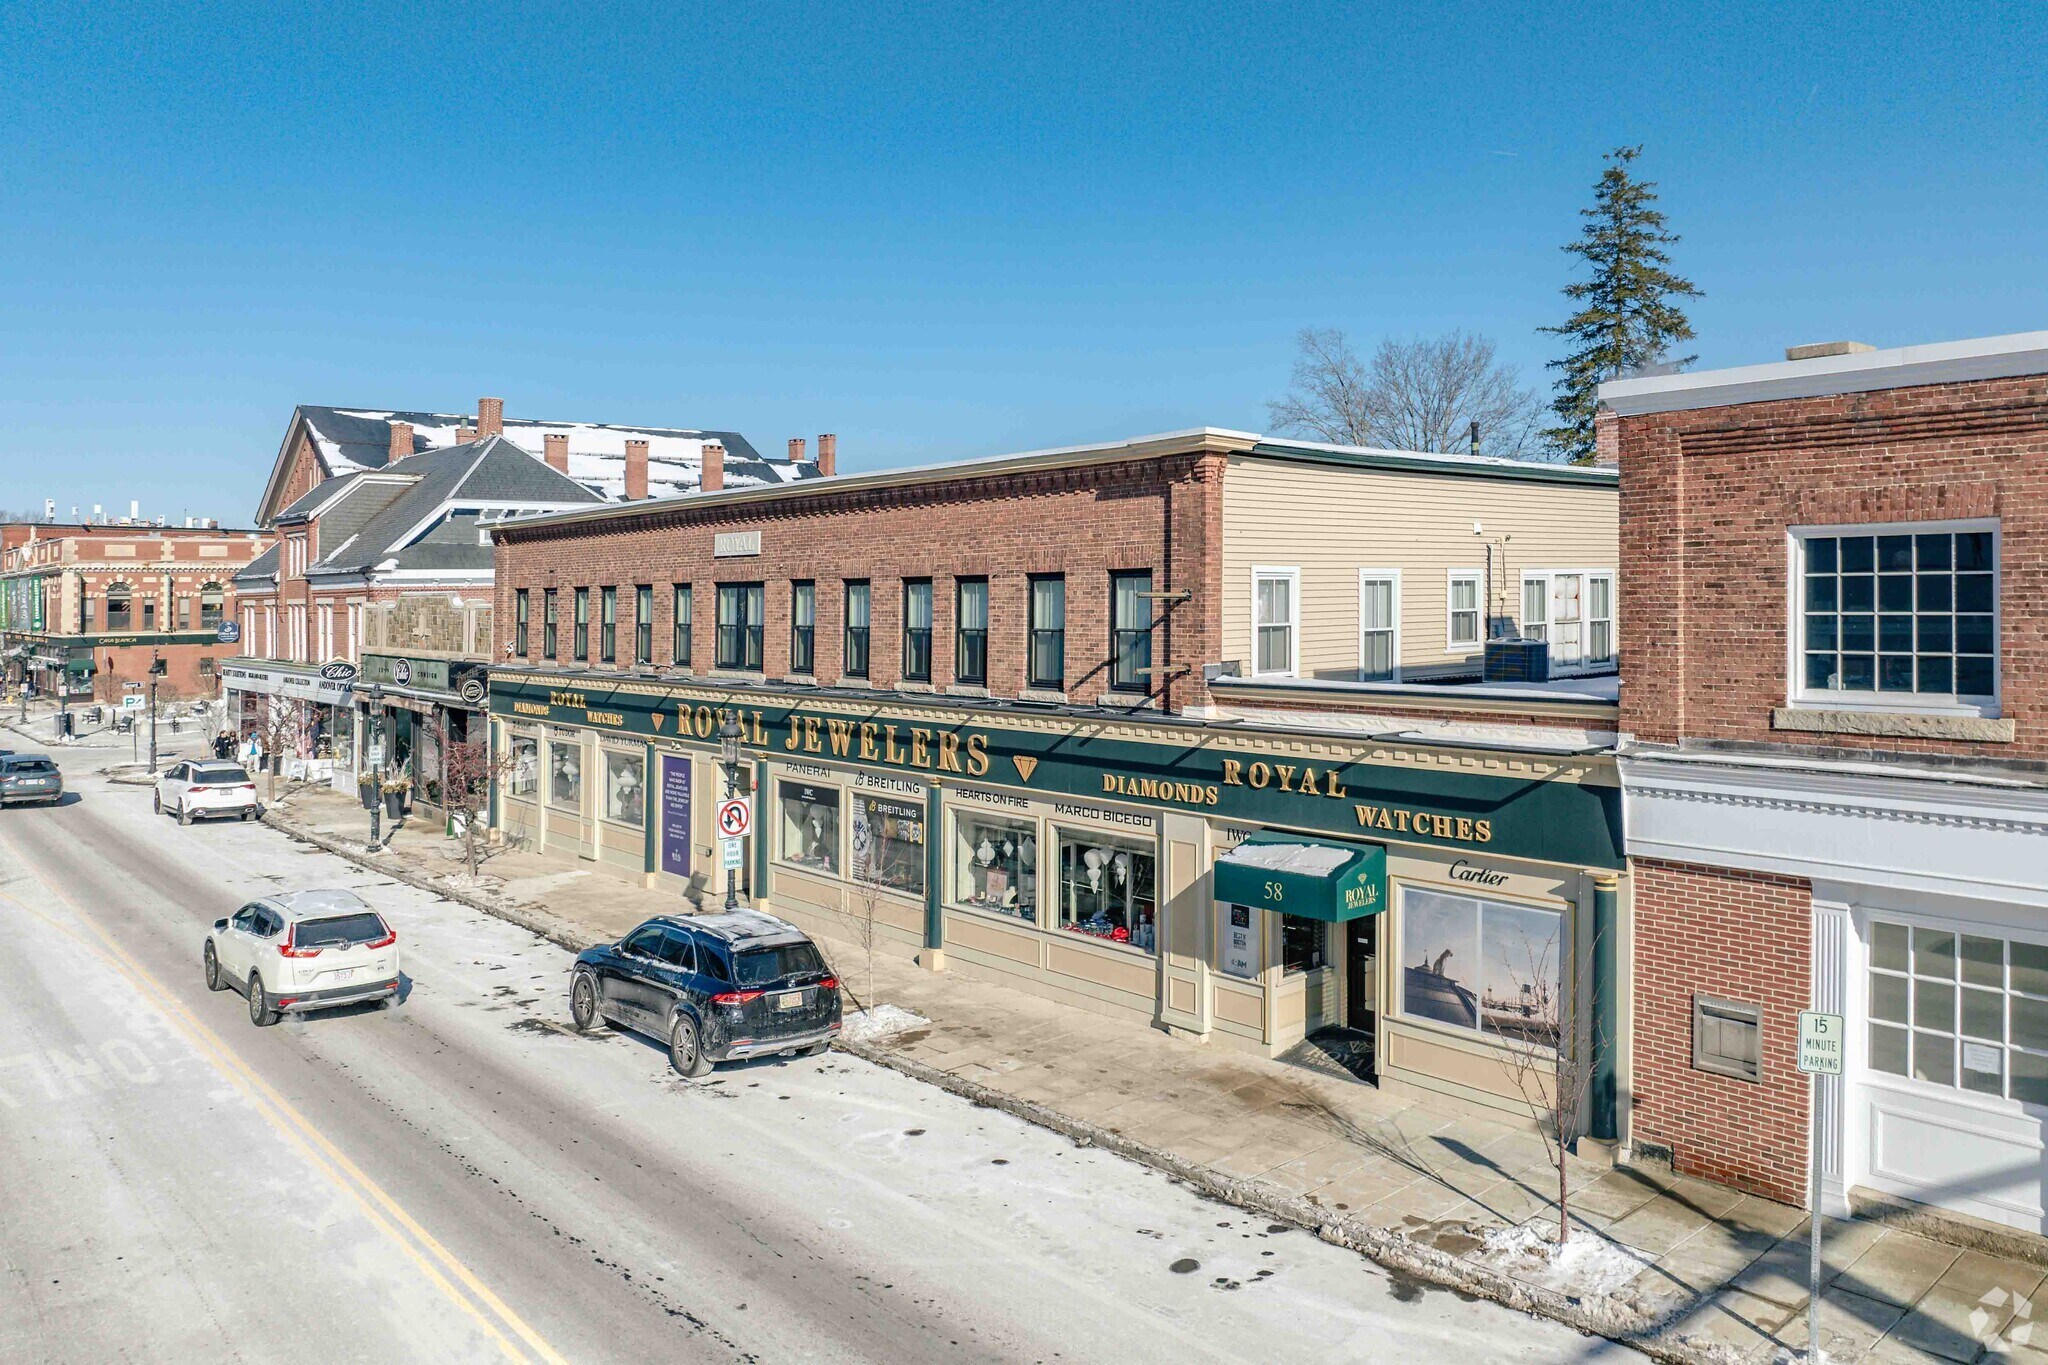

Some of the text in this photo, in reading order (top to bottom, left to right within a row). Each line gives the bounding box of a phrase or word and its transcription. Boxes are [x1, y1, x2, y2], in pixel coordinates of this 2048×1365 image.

[718, 535, 755, 553] ROYAL
[325, 665, 353, 678] Chic
[550, 691, 587, 709] ROYAL
[513, 702, 624, 727] DIAMONDS WATCHES
[600, 735, 619, 745] DAVID
[676, 703, 989, 777] ROYAL JEWELERS
[786, 762, 831, 778] PANERAI
[1222, 758, 1347, 799] ROYAL
[867, 776, 920, 794] BREITLING
[956, 788, 1029, 808] HEARTS ON FIRE
[877, 803, 917, 818] BREITLING
[1055, 803, 1152, 827] MARCO BICEGO
[1102, 773, 1492, 843] DIAMONDS WATCHES
[1449, 860, 1509, 887] Cartier
[1264, 881, 1283, 902] 58
[1344, 884, 1379, 903] ROYAL
[1347, 897, 1377, 910] JEWELERS
[1814, 1018, 1828, 1034] 15
[1806, 1038, 1837, 1052] MINUTE
[1804, 1055, 1838, 1070] PARKING
